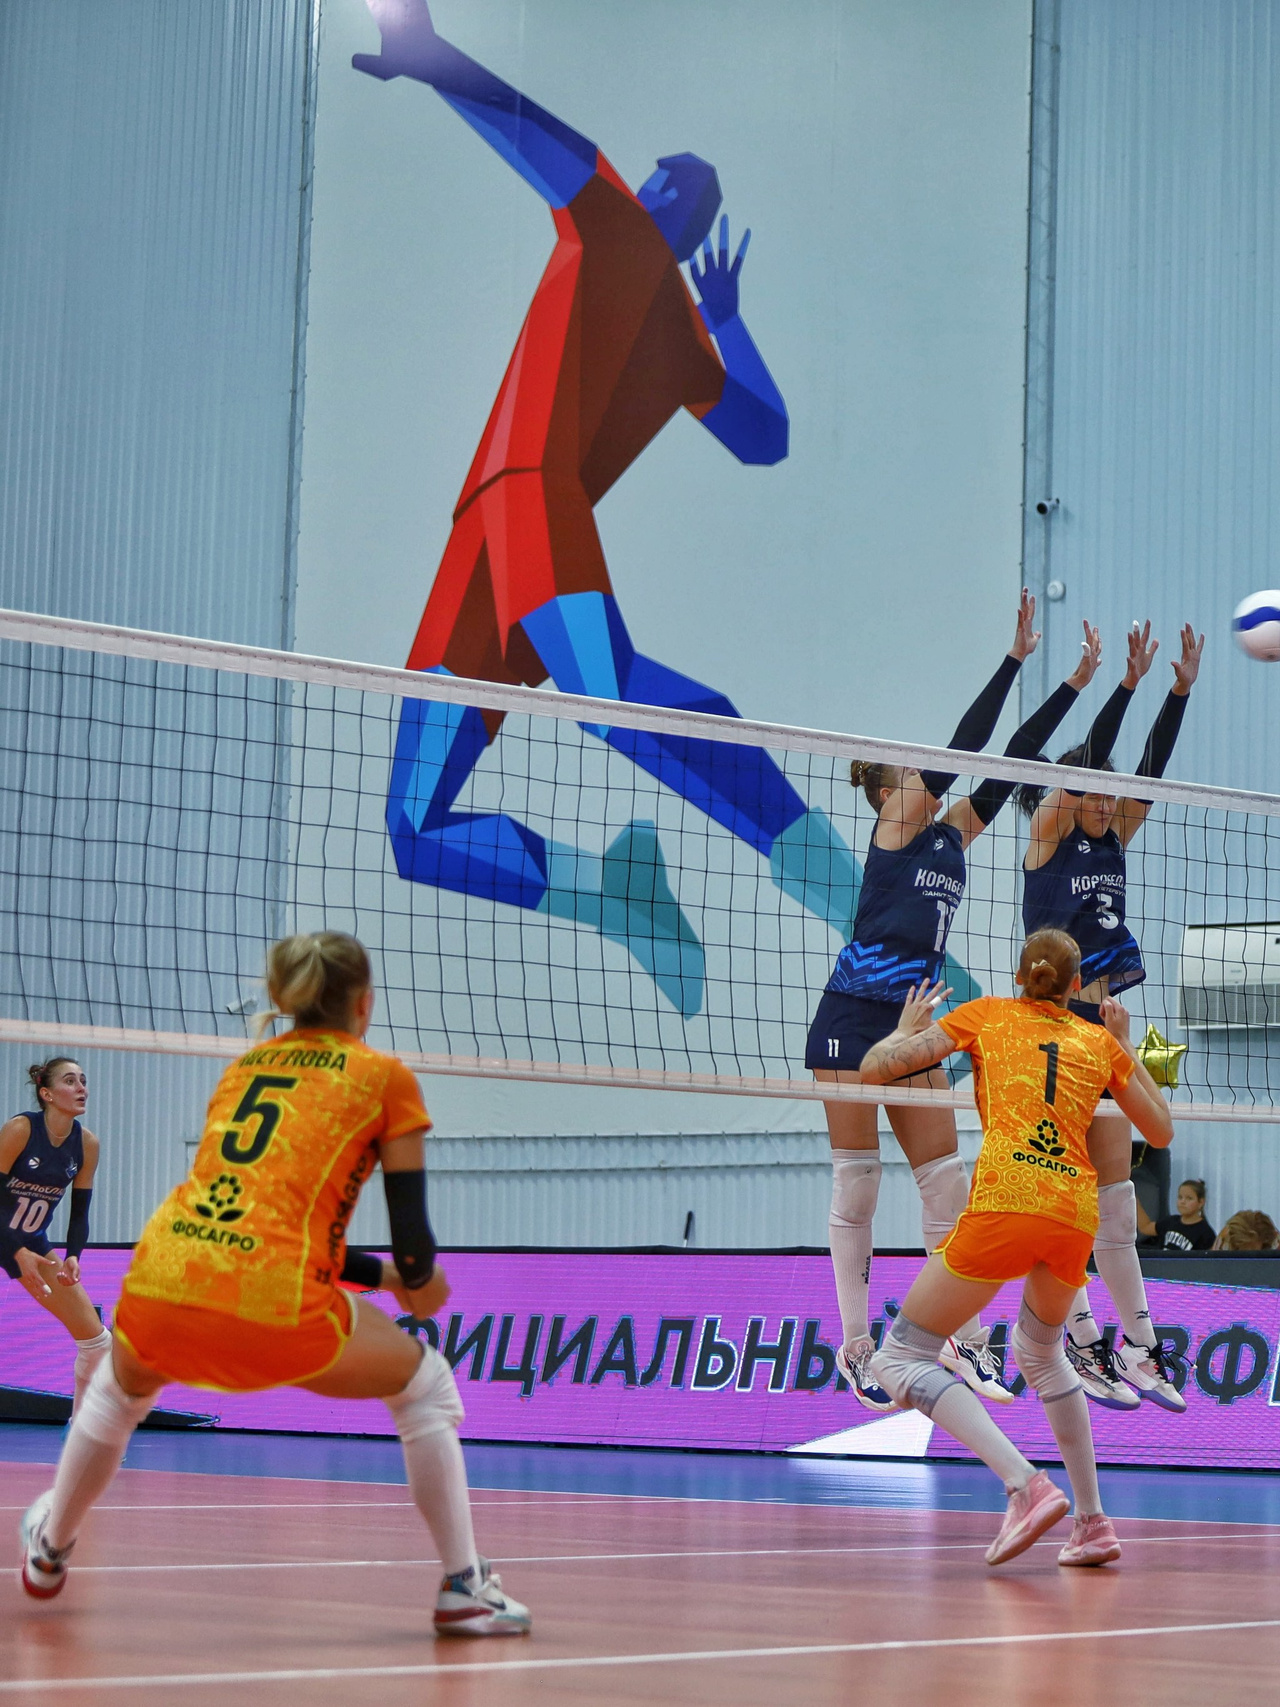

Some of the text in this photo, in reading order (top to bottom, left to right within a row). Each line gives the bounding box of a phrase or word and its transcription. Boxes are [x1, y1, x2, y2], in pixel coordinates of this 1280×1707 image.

[1096, 893, 1120, 930] 3
[827, 1038, 840, 1058] 11
[1038, 1041, 1060, 1107] 1
[220, 1074, 298, 1165] 5
[1012, 1151, 1078, 1178] ФОСАГРО
[8, 1196, 49, 1234] 10
[172, 1220, 255, 1252] ФОСАГРО
